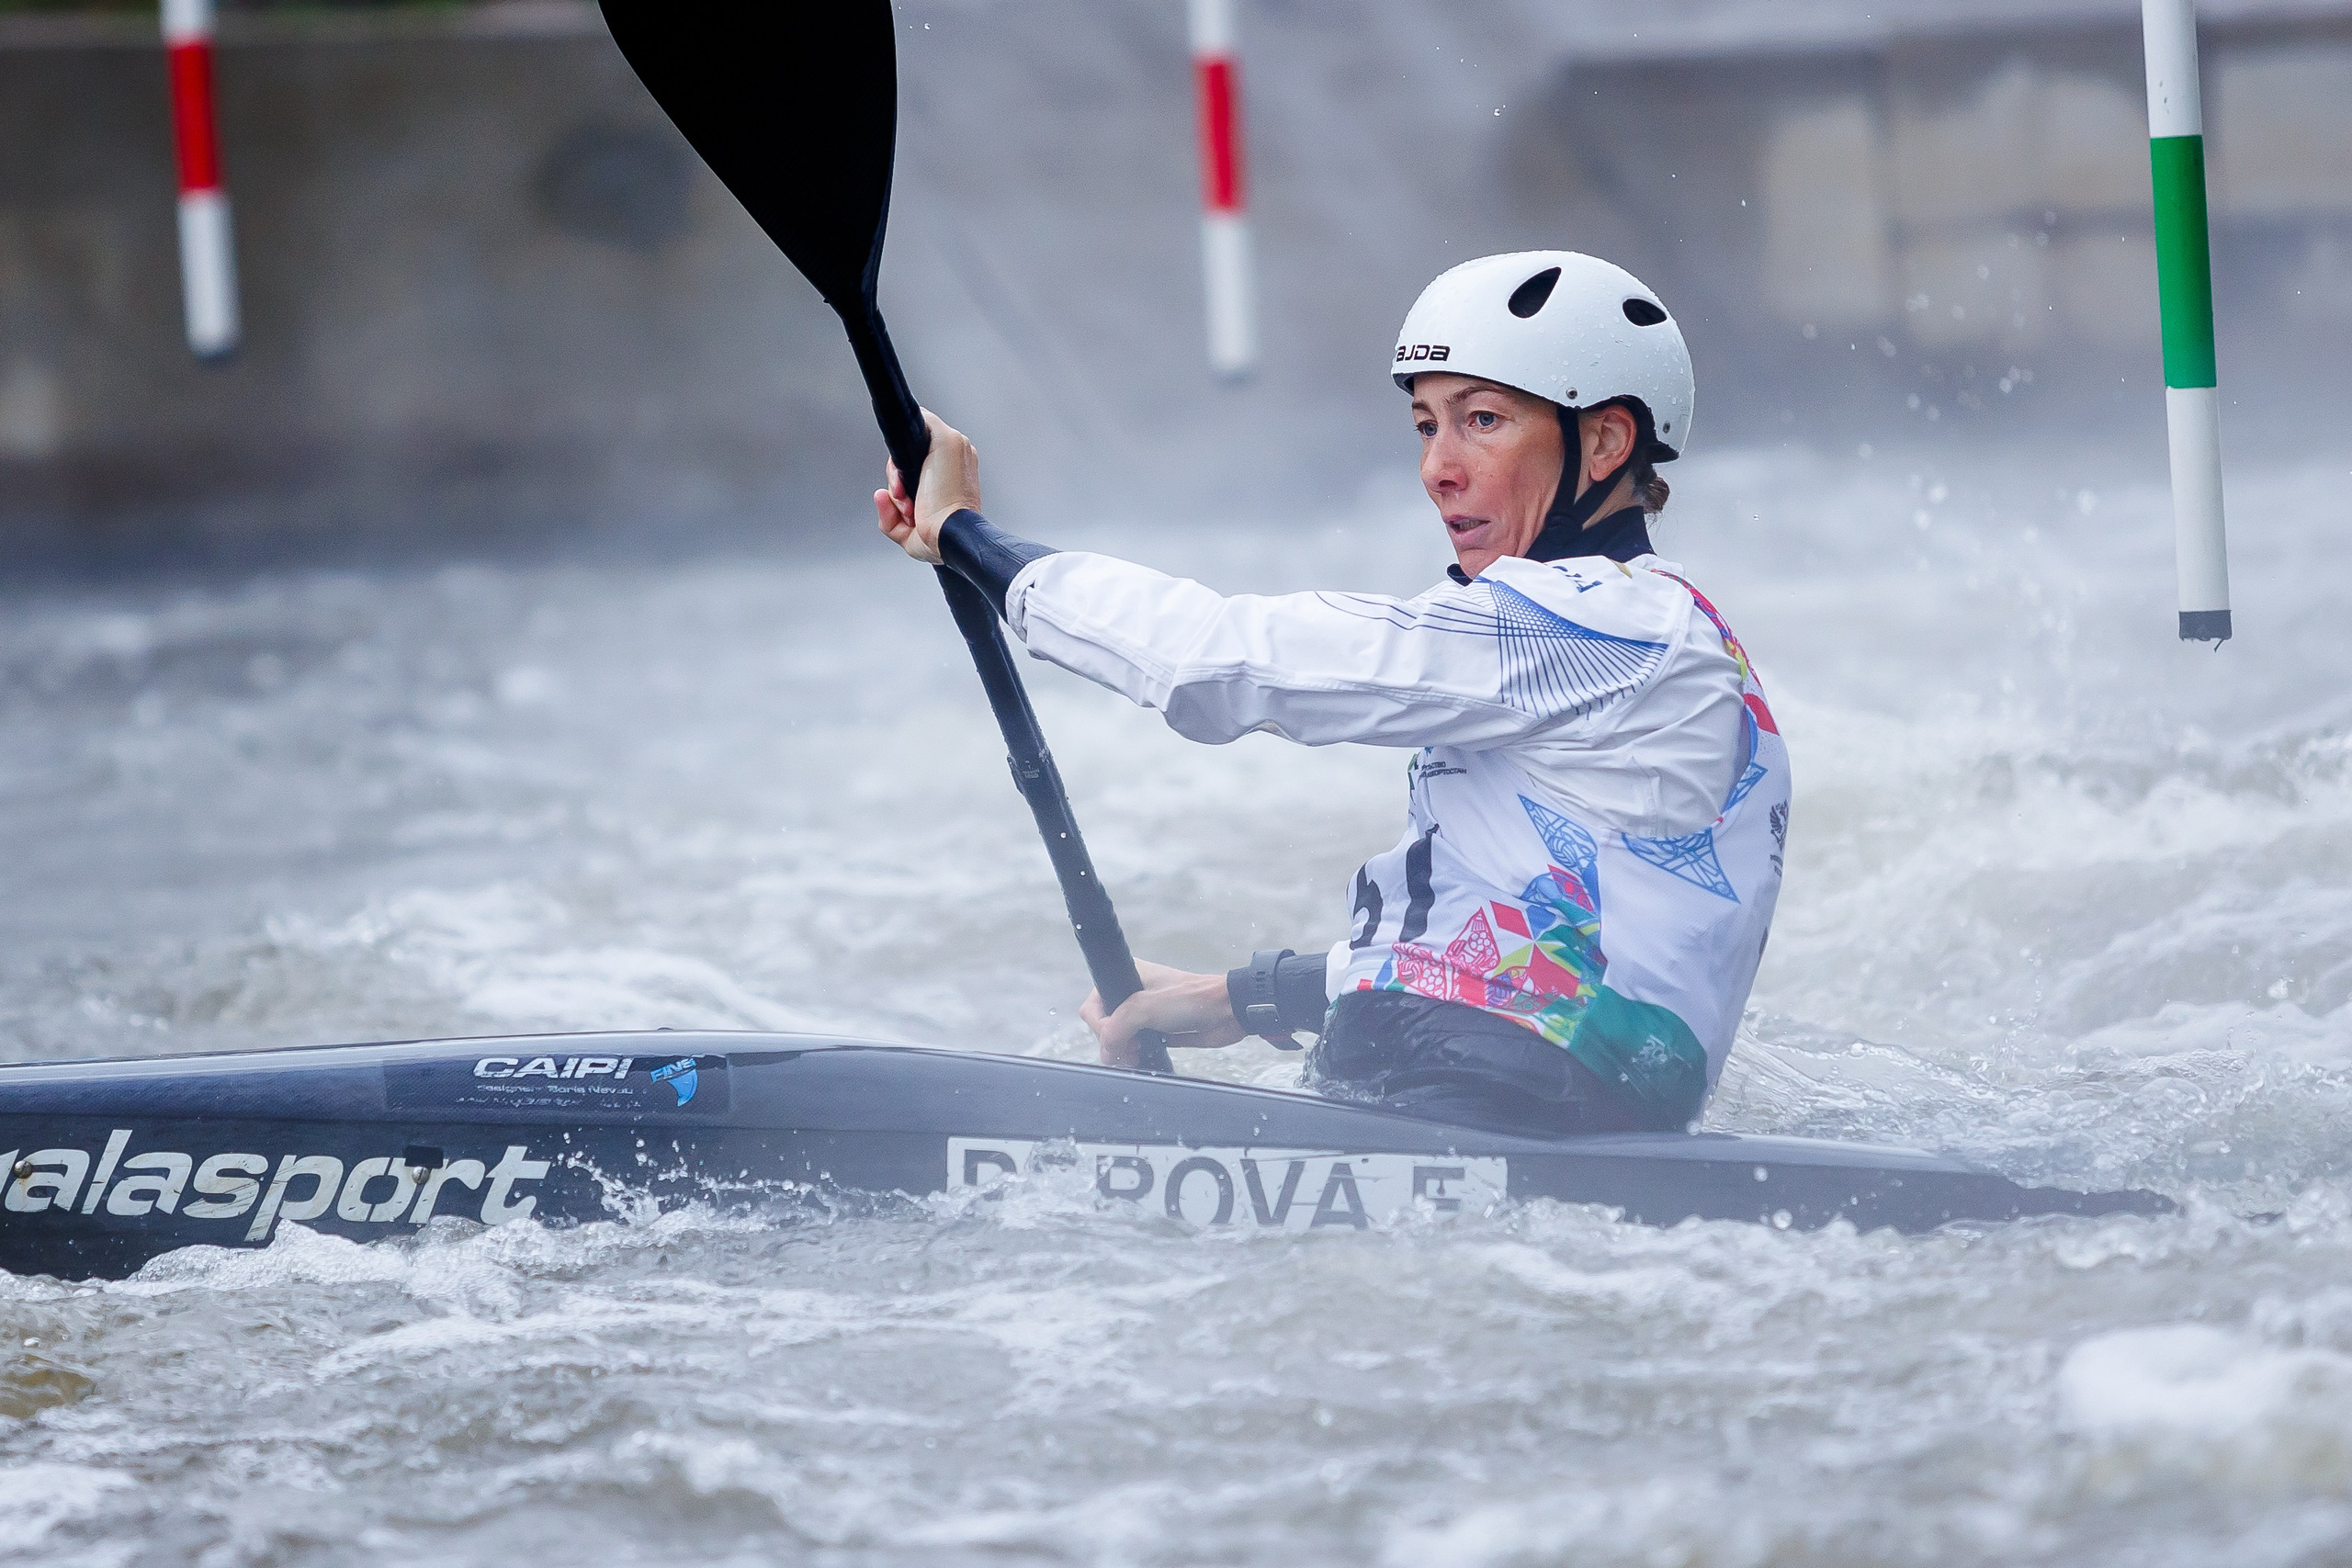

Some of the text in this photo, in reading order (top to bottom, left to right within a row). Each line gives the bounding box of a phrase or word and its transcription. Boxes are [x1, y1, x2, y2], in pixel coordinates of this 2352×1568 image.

[472, 1057, 635, 1079] CAIPI
[650, 1058, 696, 1083] FINS
[0, 1129, 550, 1242] alasport
